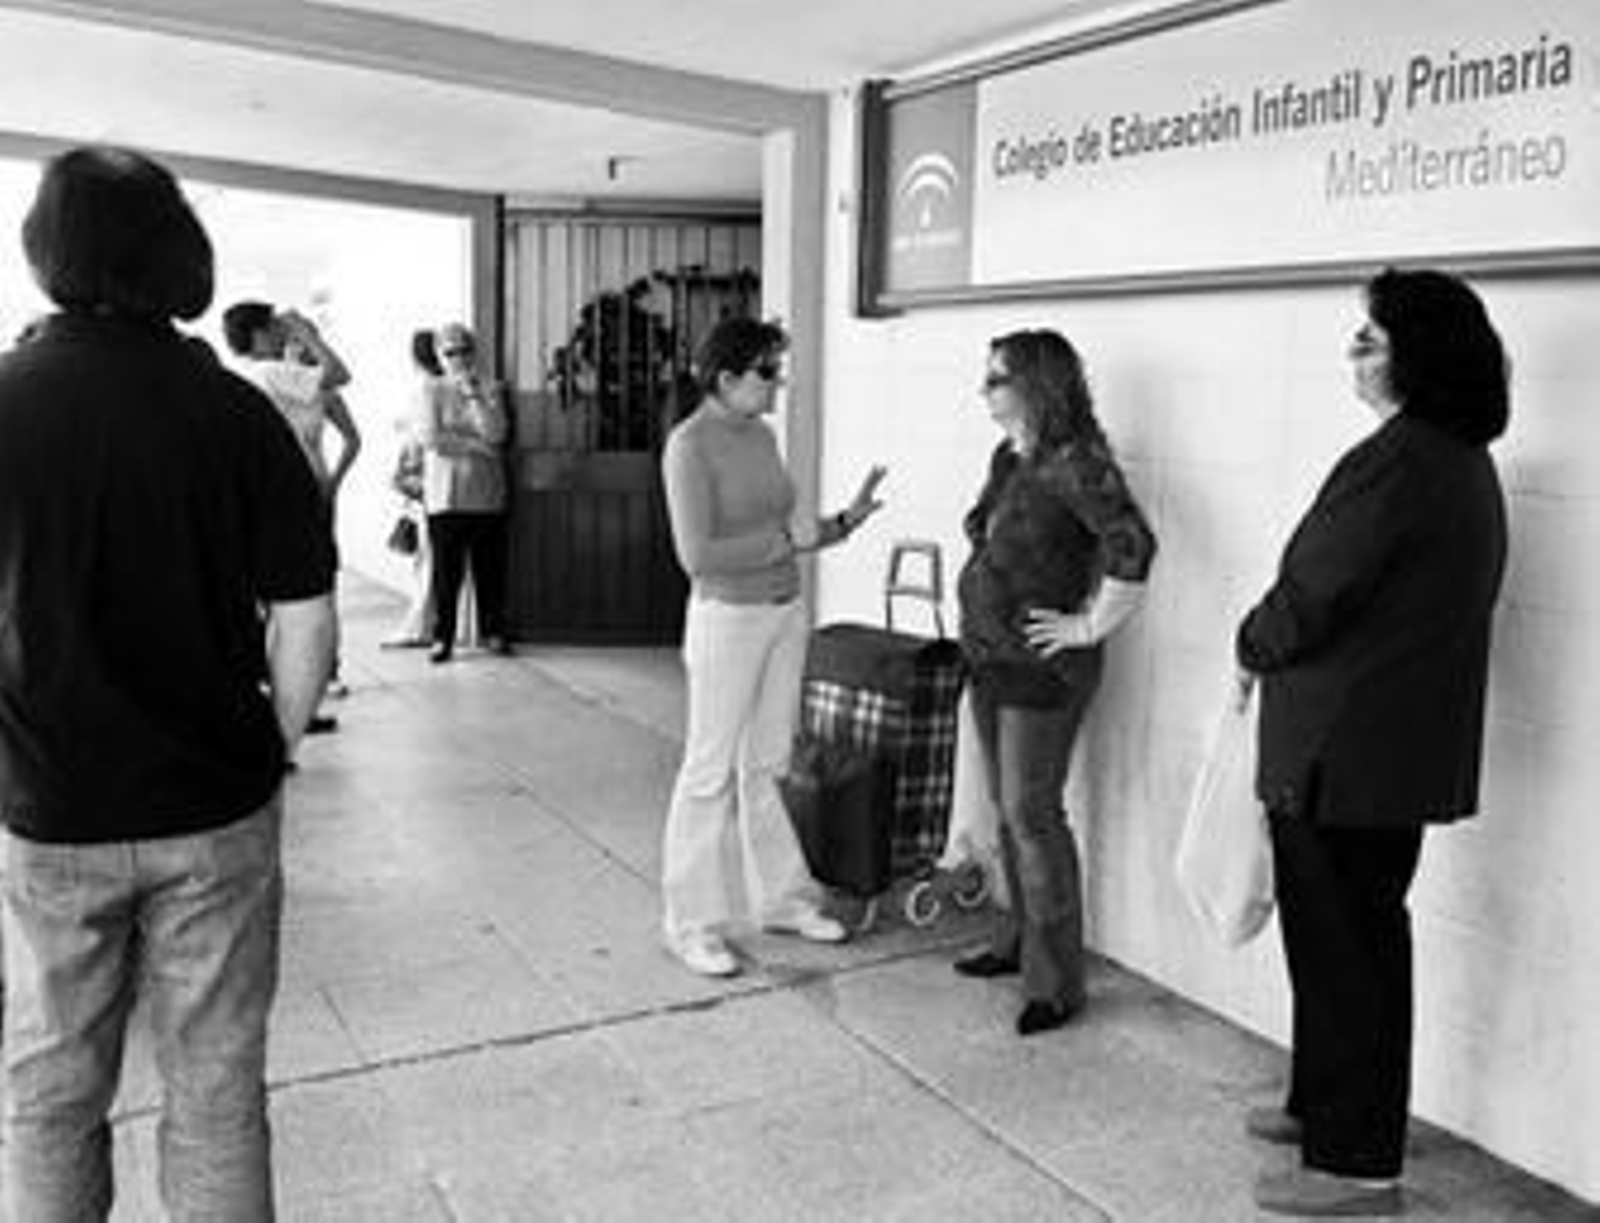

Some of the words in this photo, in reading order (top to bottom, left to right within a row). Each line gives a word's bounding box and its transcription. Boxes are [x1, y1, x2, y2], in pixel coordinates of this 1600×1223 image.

[994, 132, 1067, 180] Colegio
[1075, 125, 1102, 163] de
[1109, 95, 1240, 158] Educación
[1252, 70, 1361, 133] Infantil
[1370, 74, 1394, 127] y
[1406, 33, 1571, 109] Primaria
[1325, 129, 1566, 201] Mediterráneo
